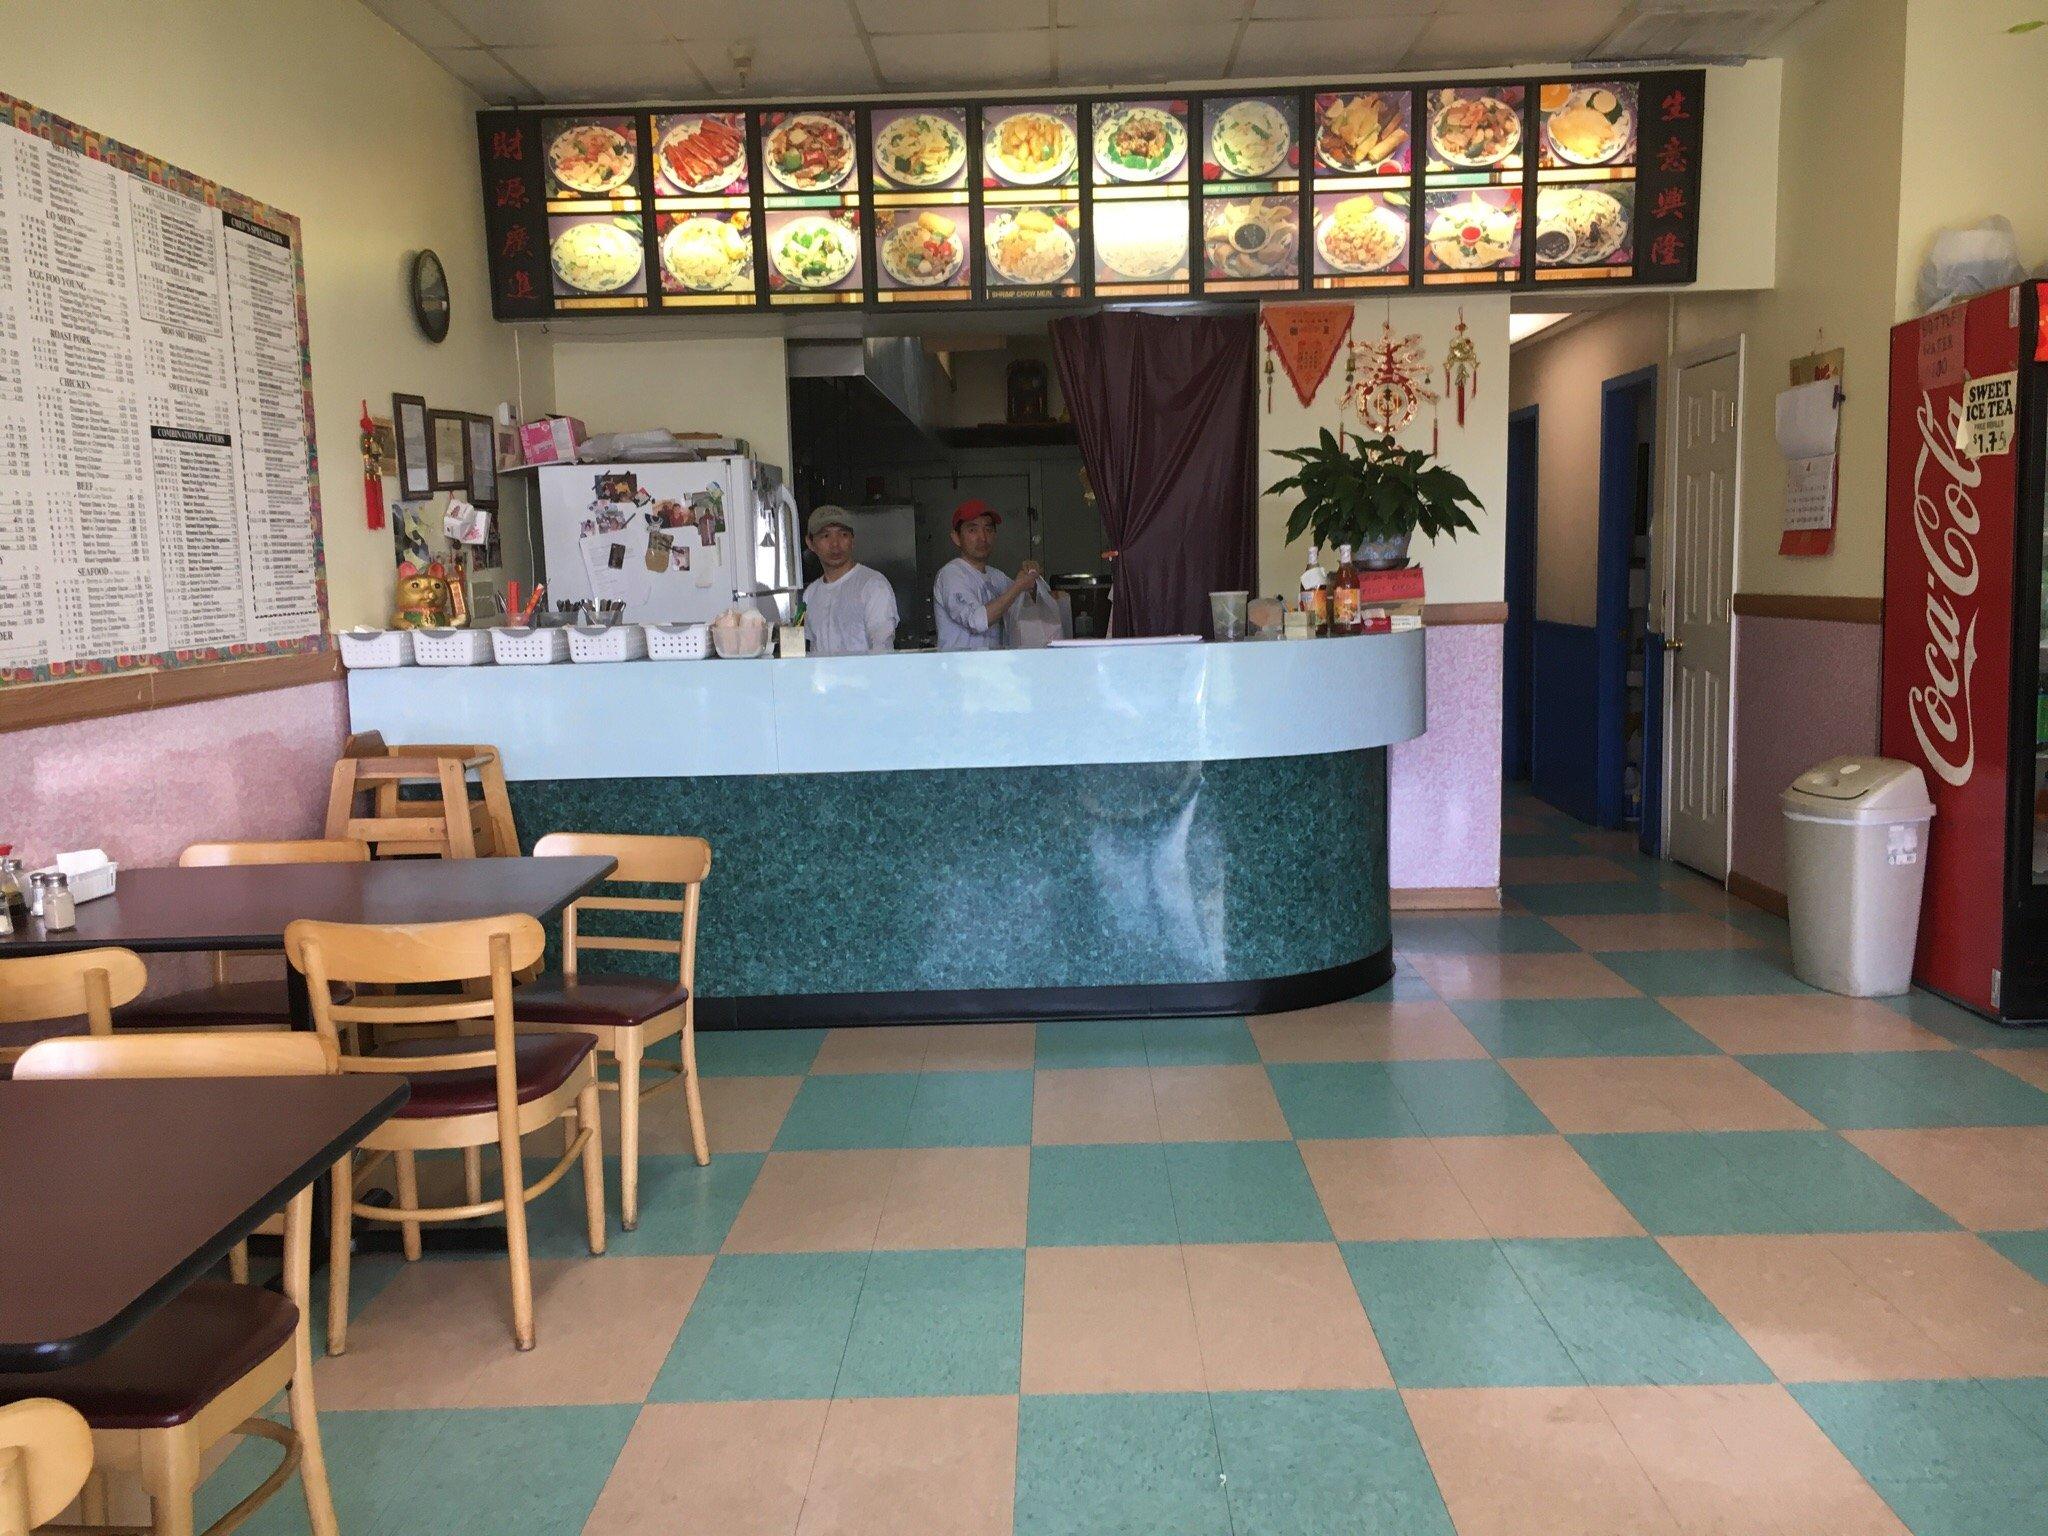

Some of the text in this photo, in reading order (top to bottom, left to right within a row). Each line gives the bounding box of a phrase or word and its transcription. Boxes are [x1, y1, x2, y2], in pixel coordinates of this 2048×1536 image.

[28, 267, 45, 280] EGG
[45, 272, 61, 284] FOO
[50, 328, 92, 346] ROAST PORK
[59, 376, 91, 389] CHICKEN
[1969, 380, 2012, 403] SWEET
[1966, 398, 2013, 422] ICE TEA
[157, 428, 225, 444] COMBINATION PLATTERS
[76, 481, 93, 491] BEEF
[77, 566, 109, 577] SEAFOOD
